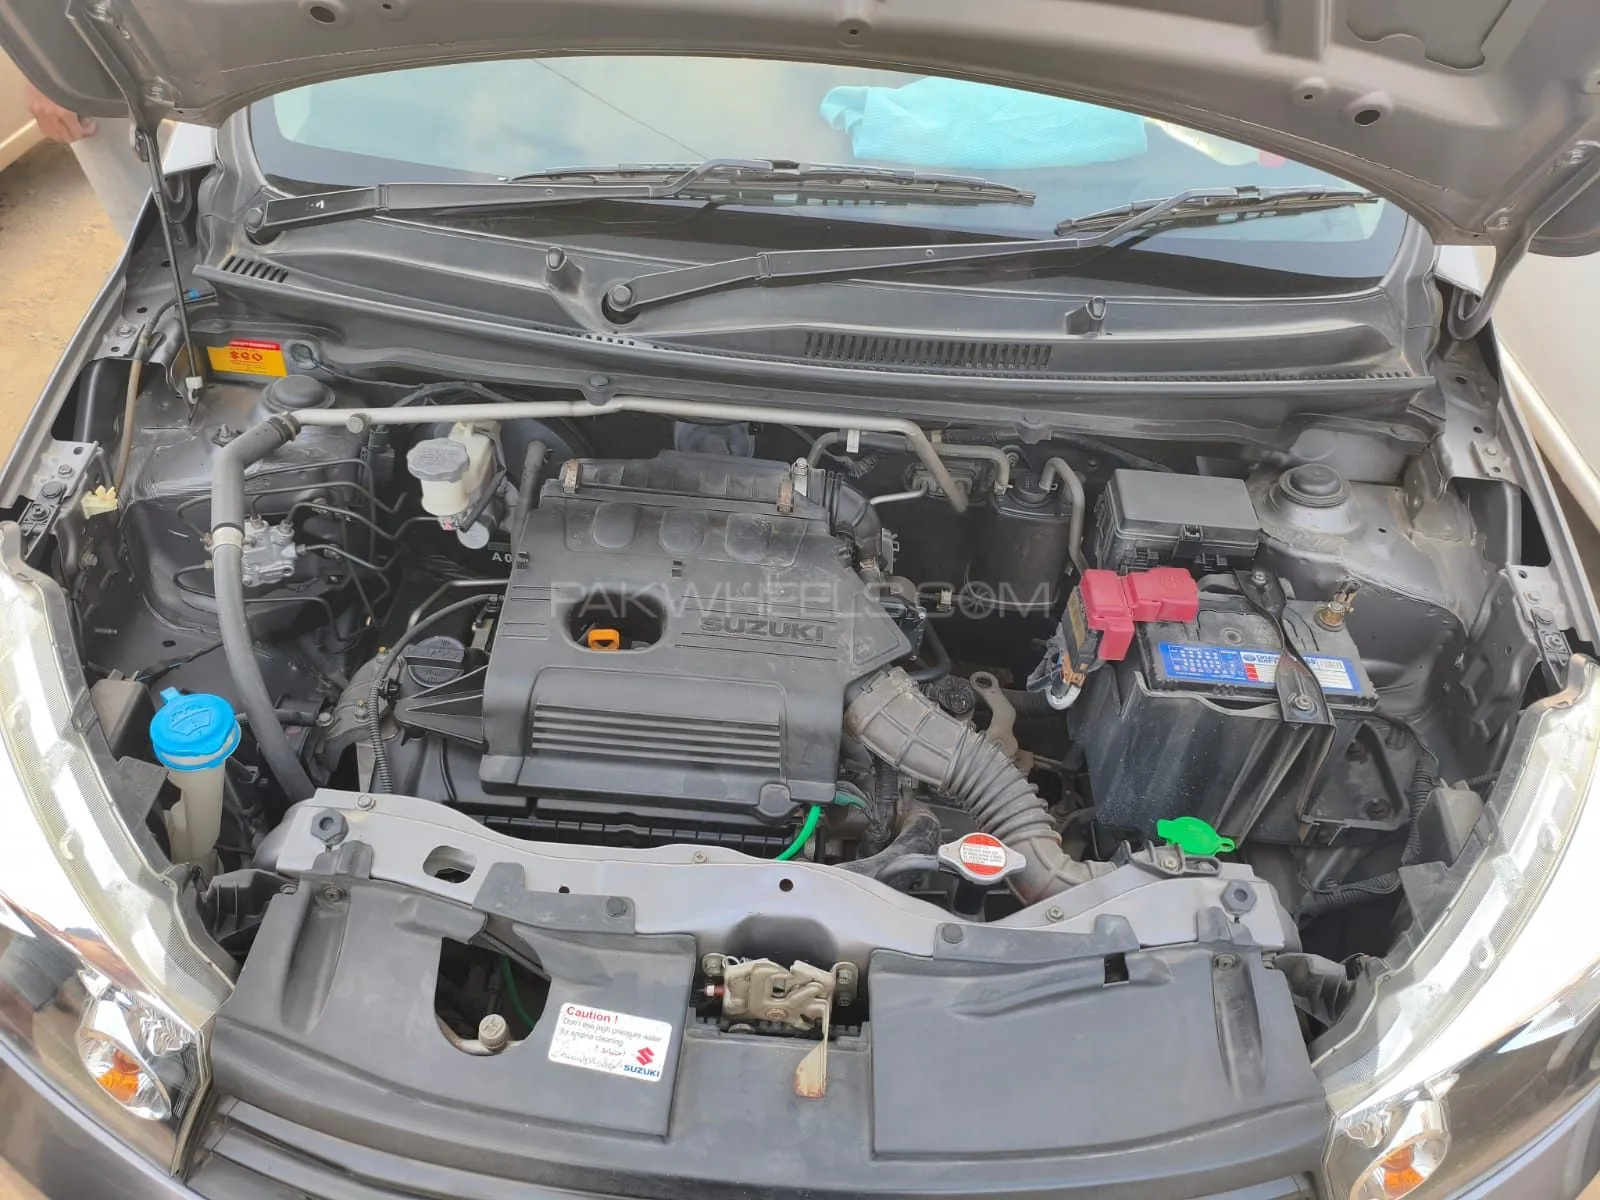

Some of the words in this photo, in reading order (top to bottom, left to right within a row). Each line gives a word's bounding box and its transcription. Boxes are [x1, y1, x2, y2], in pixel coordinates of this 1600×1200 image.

[700, 616, 824, 643] SUZUKI
[566, 1006, 611, 1023] Caution
[623, 1064, 660, 1078] SUZUKI
